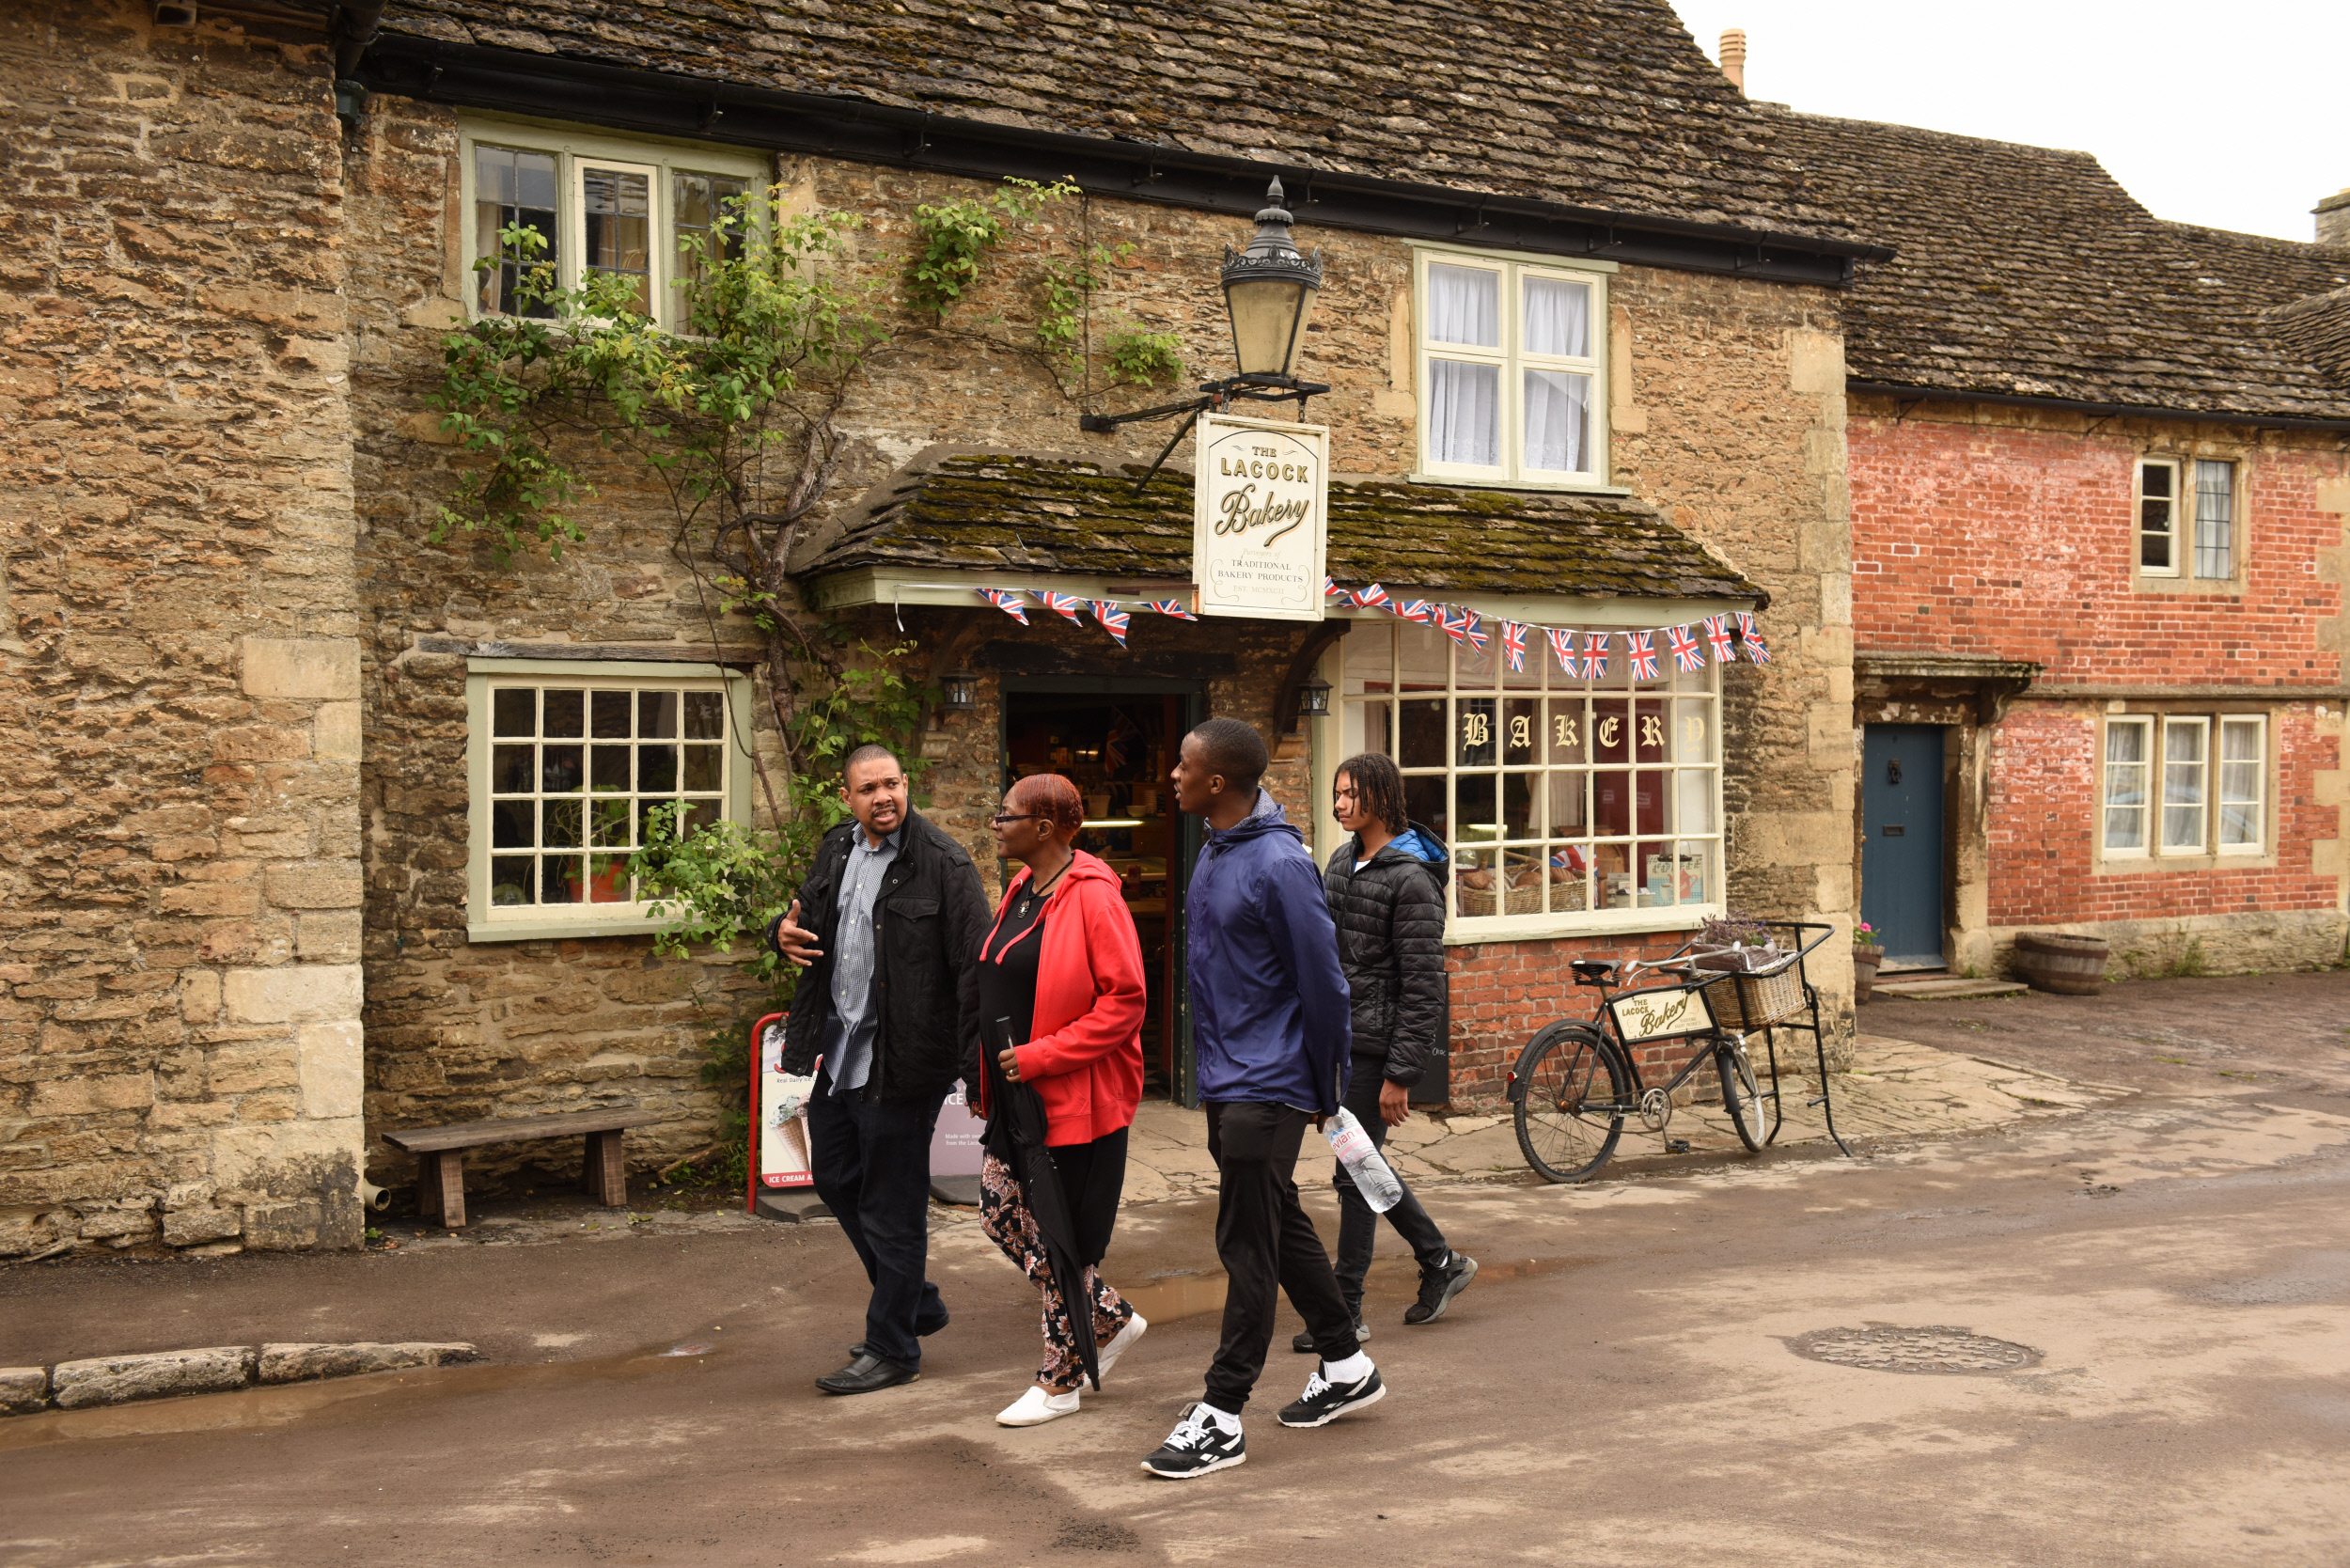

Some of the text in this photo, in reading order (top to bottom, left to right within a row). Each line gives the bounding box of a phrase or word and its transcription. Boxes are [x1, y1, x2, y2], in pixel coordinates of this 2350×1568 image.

[1251, 446, 1277, 458] THE
[1220, 457, 1309, 483] LACOCK
[1214, 482, 1311, 548] Bakery
[1242, 548, 1282, 560] Purveyors of
[1231, 558, 1292, 571] TRADITIONAL
[1217, 570, 1304, 583] BAKERY PRODUCTS
[1251, 587, 1284, 595] MCMXCII
[1463, 713, 1705, 752] BAKERY
[1634, 998, 1649, 1007] THE
[1622, 1006, 1650, 1017] LACOCK
[1638, 996, 1689, 1037] Bakery
[943, 1093, 964, 1105] ICE
[1333, 1131, 1355, 1152] evian
[781, 1174, 806, 1183] CREAM
